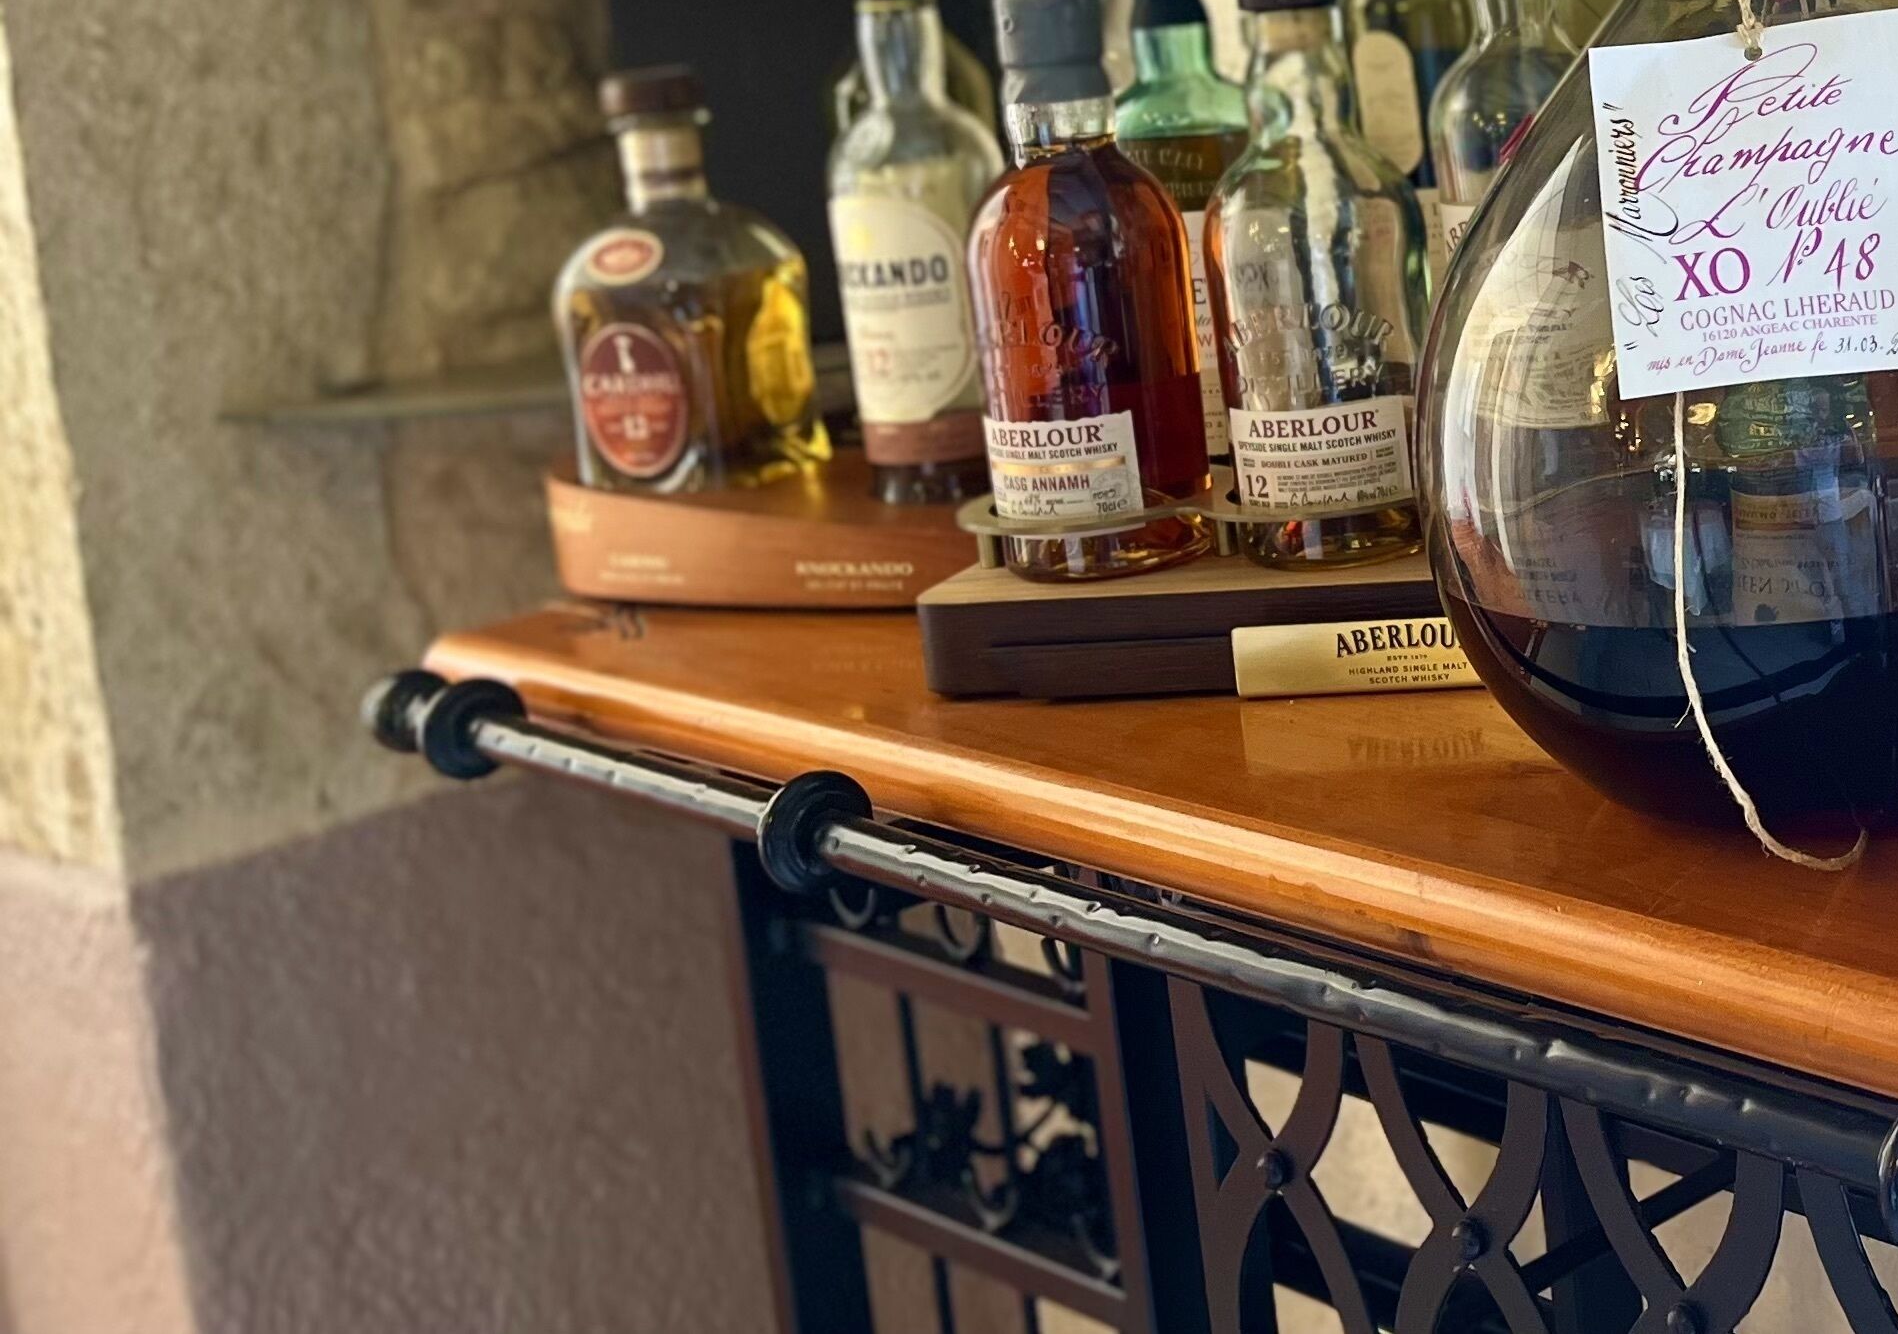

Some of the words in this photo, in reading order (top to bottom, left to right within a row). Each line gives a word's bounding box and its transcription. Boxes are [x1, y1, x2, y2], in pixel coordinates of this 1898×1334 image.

[1658, 43, 1852, 135] Petite
[1680, 300, 1776, 330] COGNAC
[1785, 289, 1895, 318] LHERAUD
[1703, 330, 1737, 342] 16120
[1740, 320, 1799, 337] ANGEAC
[1802, 314, 1878, 331] CHARENTE
[1740, 338, 1806, 373] Jeanne
[992, 424, 1103, 448] ABERLOUR
[1249, 410, 1377, 438] ABERLOUR
[1028, 450, 1046, 459] MALT
[1049, 449, 1082, 458] SCOTCH
[1085, 442, 1118, 454] WHISKY
[1269, 442, 1297, 452] SINGLE
[1300, 442, 1322, 451] MALT
[1325, 437, 1361, 450] SCOTCH
[1364, 428, 1396, 443] WHISKY
[1294, 459, 1318, 468] CASK
[1321, 453, 1368, 465] MATURED
[1032, 474, 1090, 491] ANNAMH
[1245, 474, 1269, 498] 12
[1337, 623, 1462, 658] ABERLOU
[1349, 665, 1399, 675] HIGHLAND
[1403, 663, 1438, 673] SINGLE
[1443, 661, 1468, 671] MALT
[1369, 675, 1408, 684] SCOTCH
[1411, 673, 1450, 683] WHISKY
